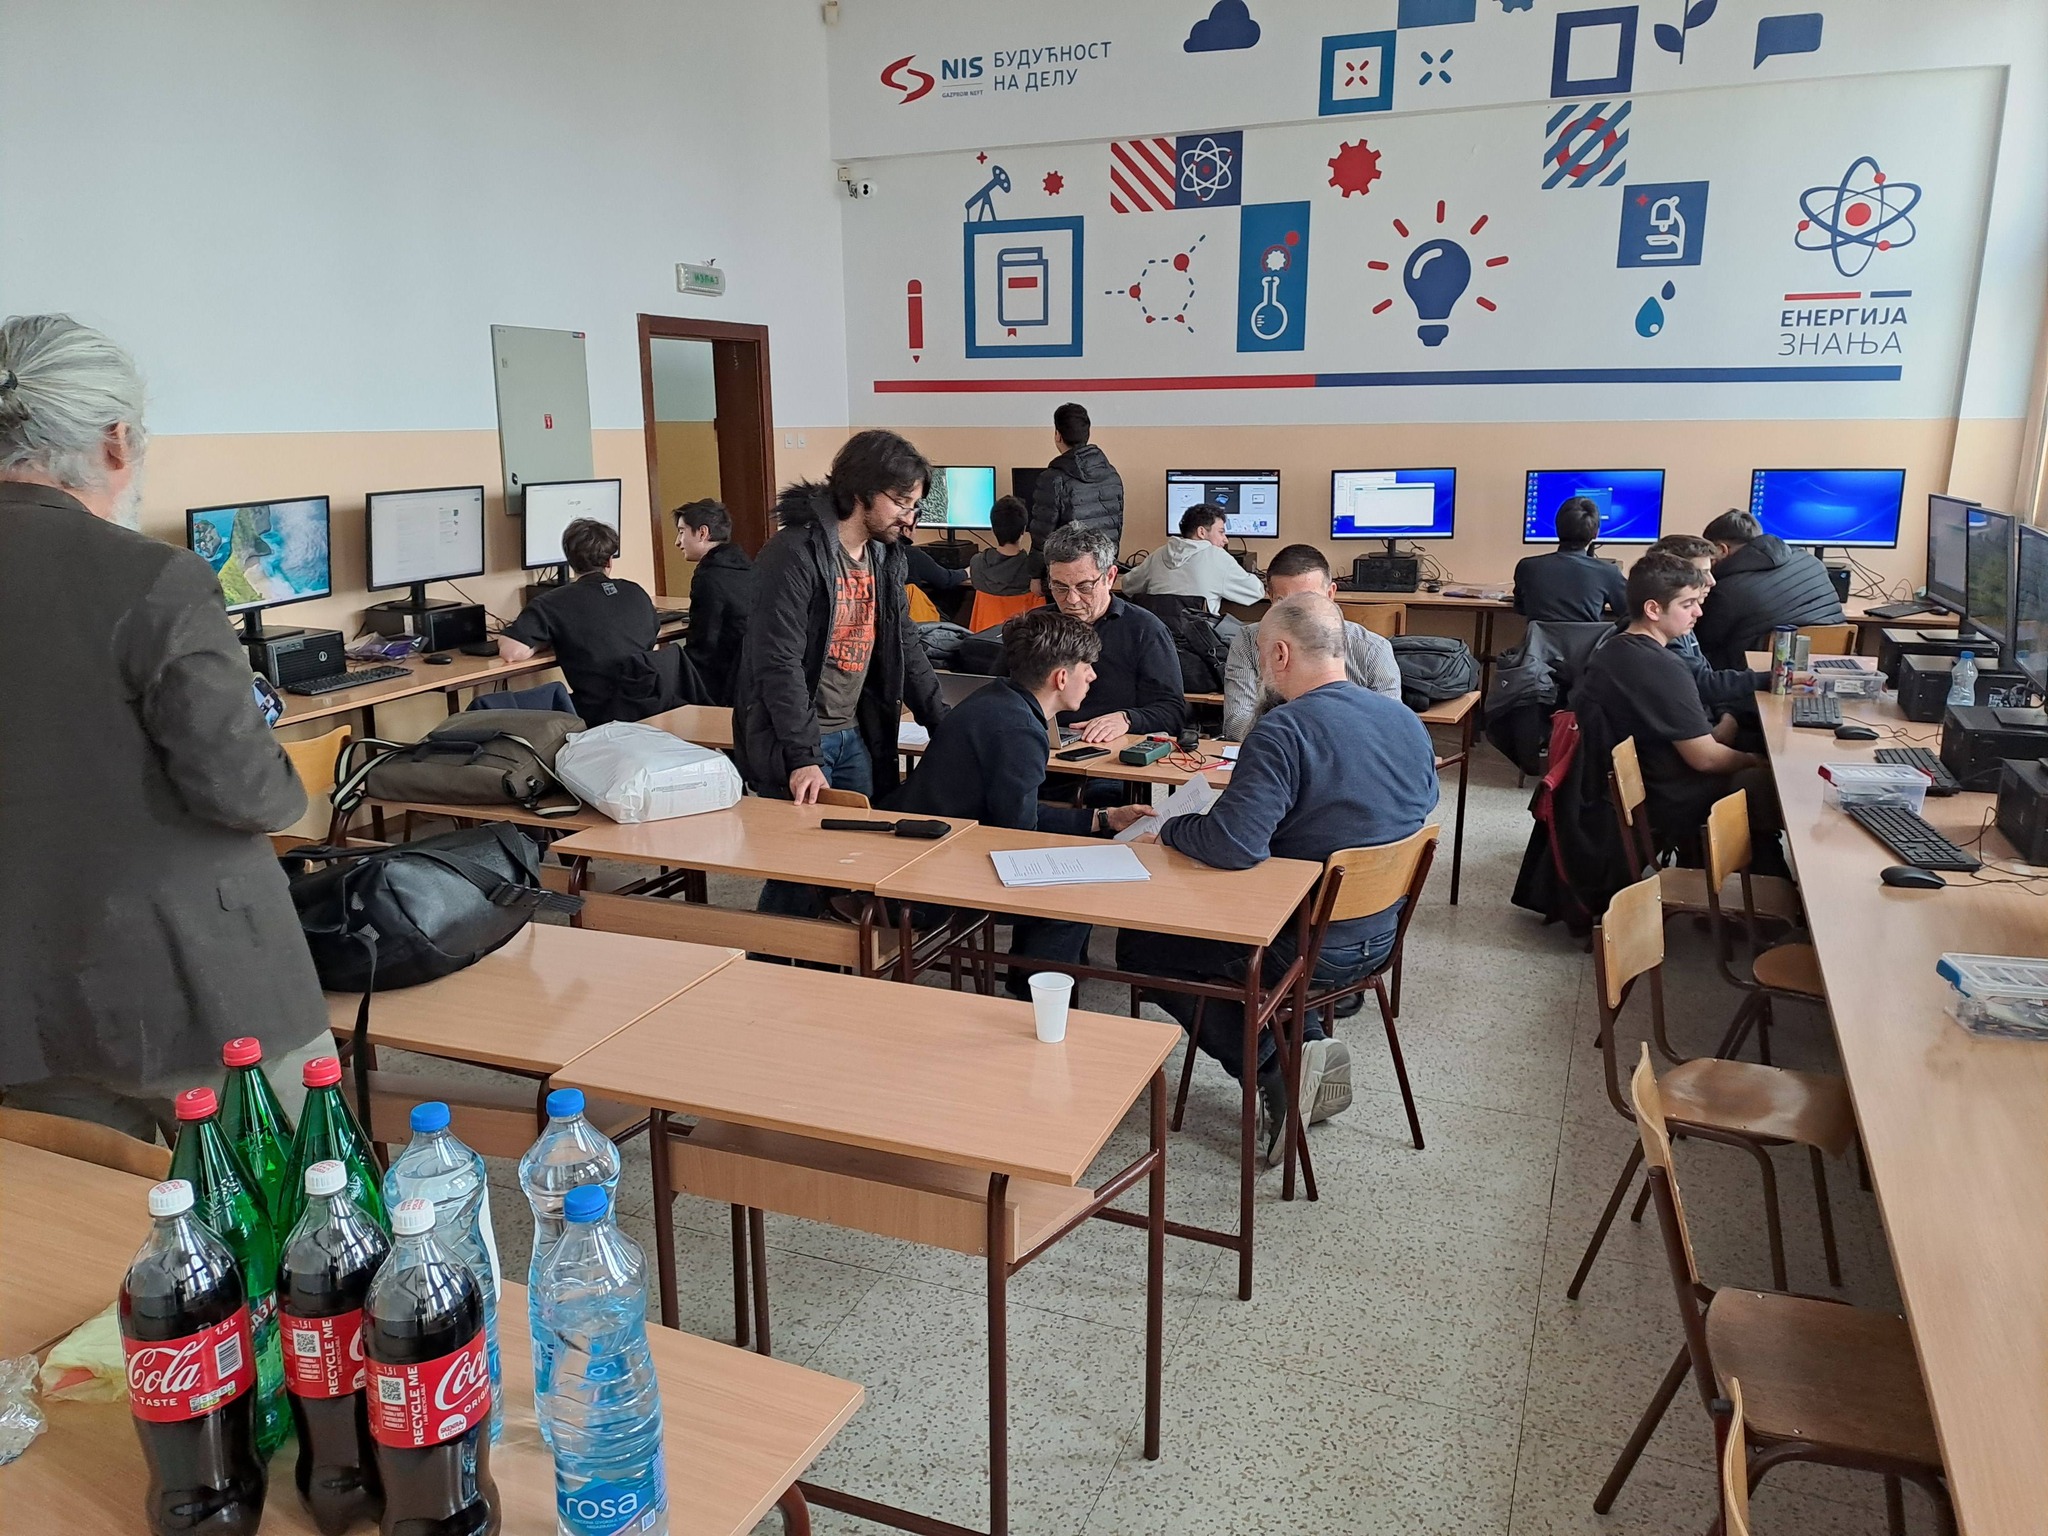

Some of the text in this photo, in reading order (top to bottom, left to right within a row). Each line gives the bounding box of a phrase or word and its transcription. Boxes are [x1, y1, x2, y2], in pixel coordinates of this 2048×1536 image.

[994, 41, 1112, 69] БУДУЋНОСТ
[941, 56, 983, 80] NIS
[994, 68, 1078, 93] НА ДЕЛУ
[1780, 307, 1908, 327] ЕНЕРГИЈА
[1778, 331, 1902, 356] ЗНАЊА
[215, 1321, 230, 1335] 1,5
[322, 1319, 340, 1396] RECYCLE ME
[139, 1396, 178, 1407] TASTE
[407, 1365, 424, 1446] RECYCLE ME
[566, 1493, 637, 1519] rosa
